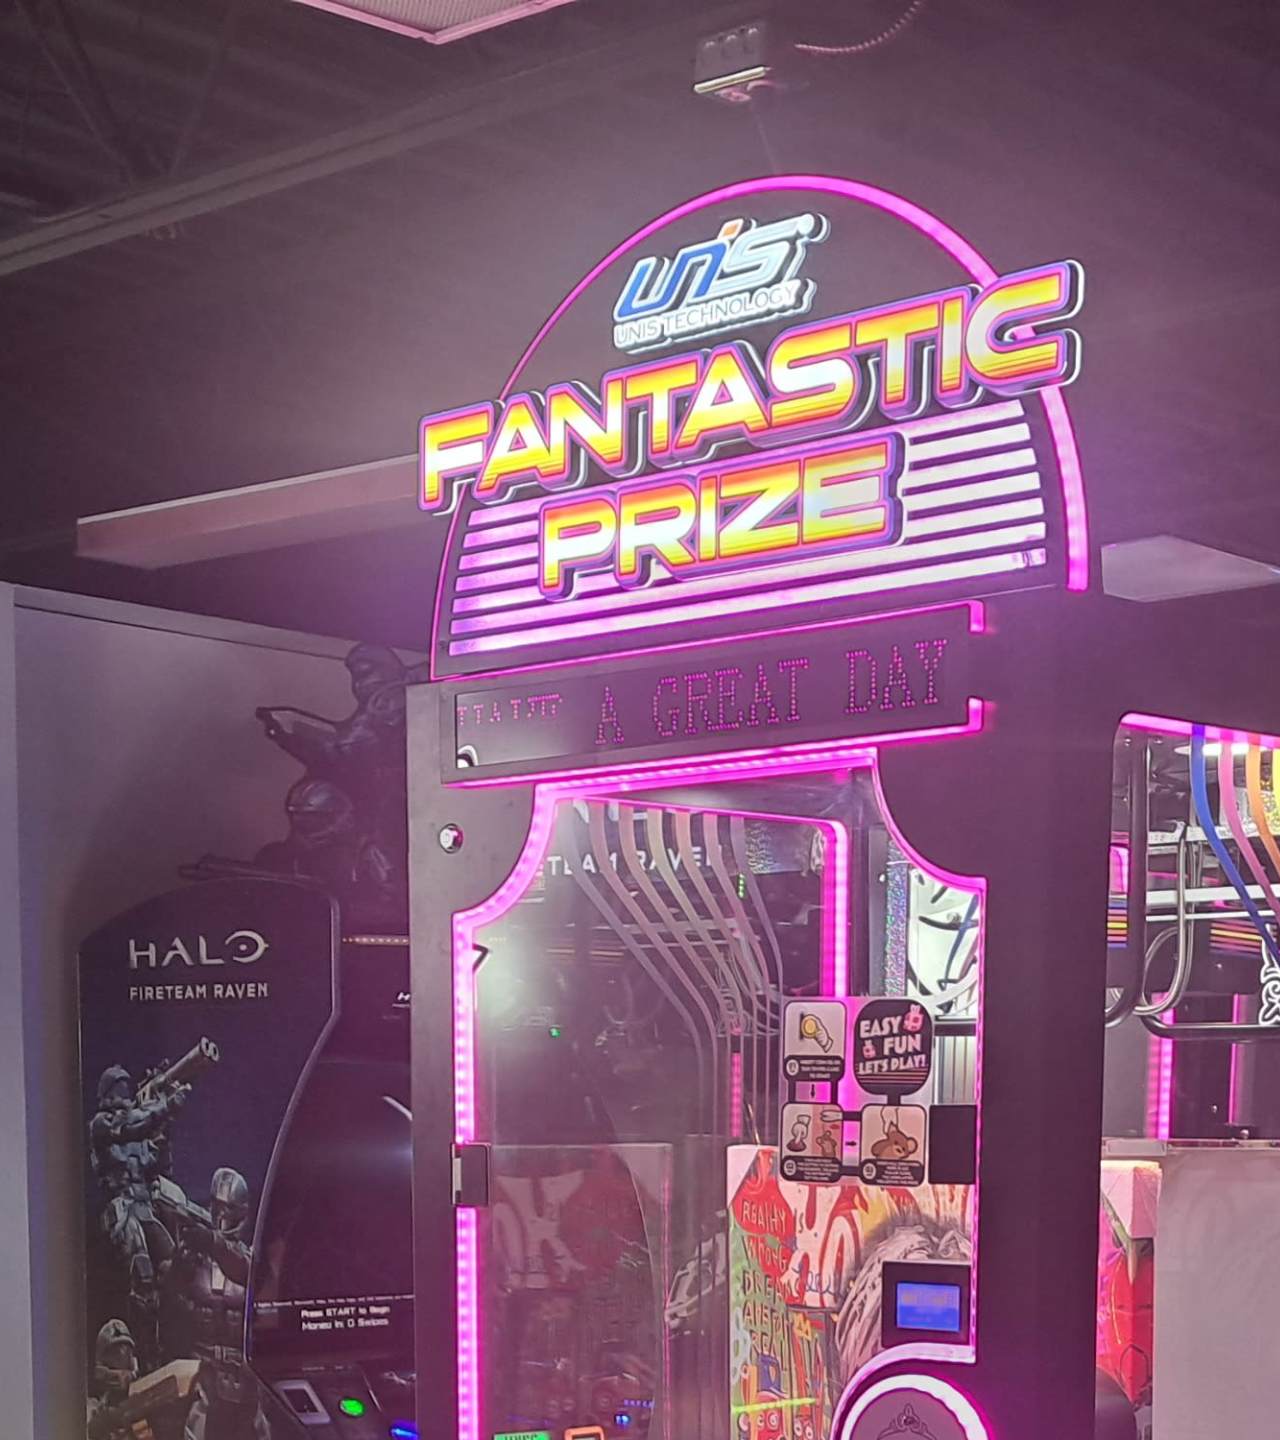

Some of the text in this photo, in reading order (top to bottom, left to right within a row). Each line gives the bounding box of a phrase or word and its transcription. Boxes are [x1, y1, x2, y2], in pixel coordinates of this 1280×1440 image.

[615, 283, 797, 344] UNIS TECHNOLOGY
[422, 266, 1070, 507] FANTASTIC
[541, 438, 892, 593] PRIZE
[595, 686, 624, 745] A
[652, 658, 810, 737] GREAT
[843, 639, 948, 714] DAY
[128, 931, 270, 969] HALO
[129, 982, 269, 1000] FIRETEAM RAVEN
[860, 1015, 902, 1039] EASY
[883, 1034, 922, 1056] FUN
